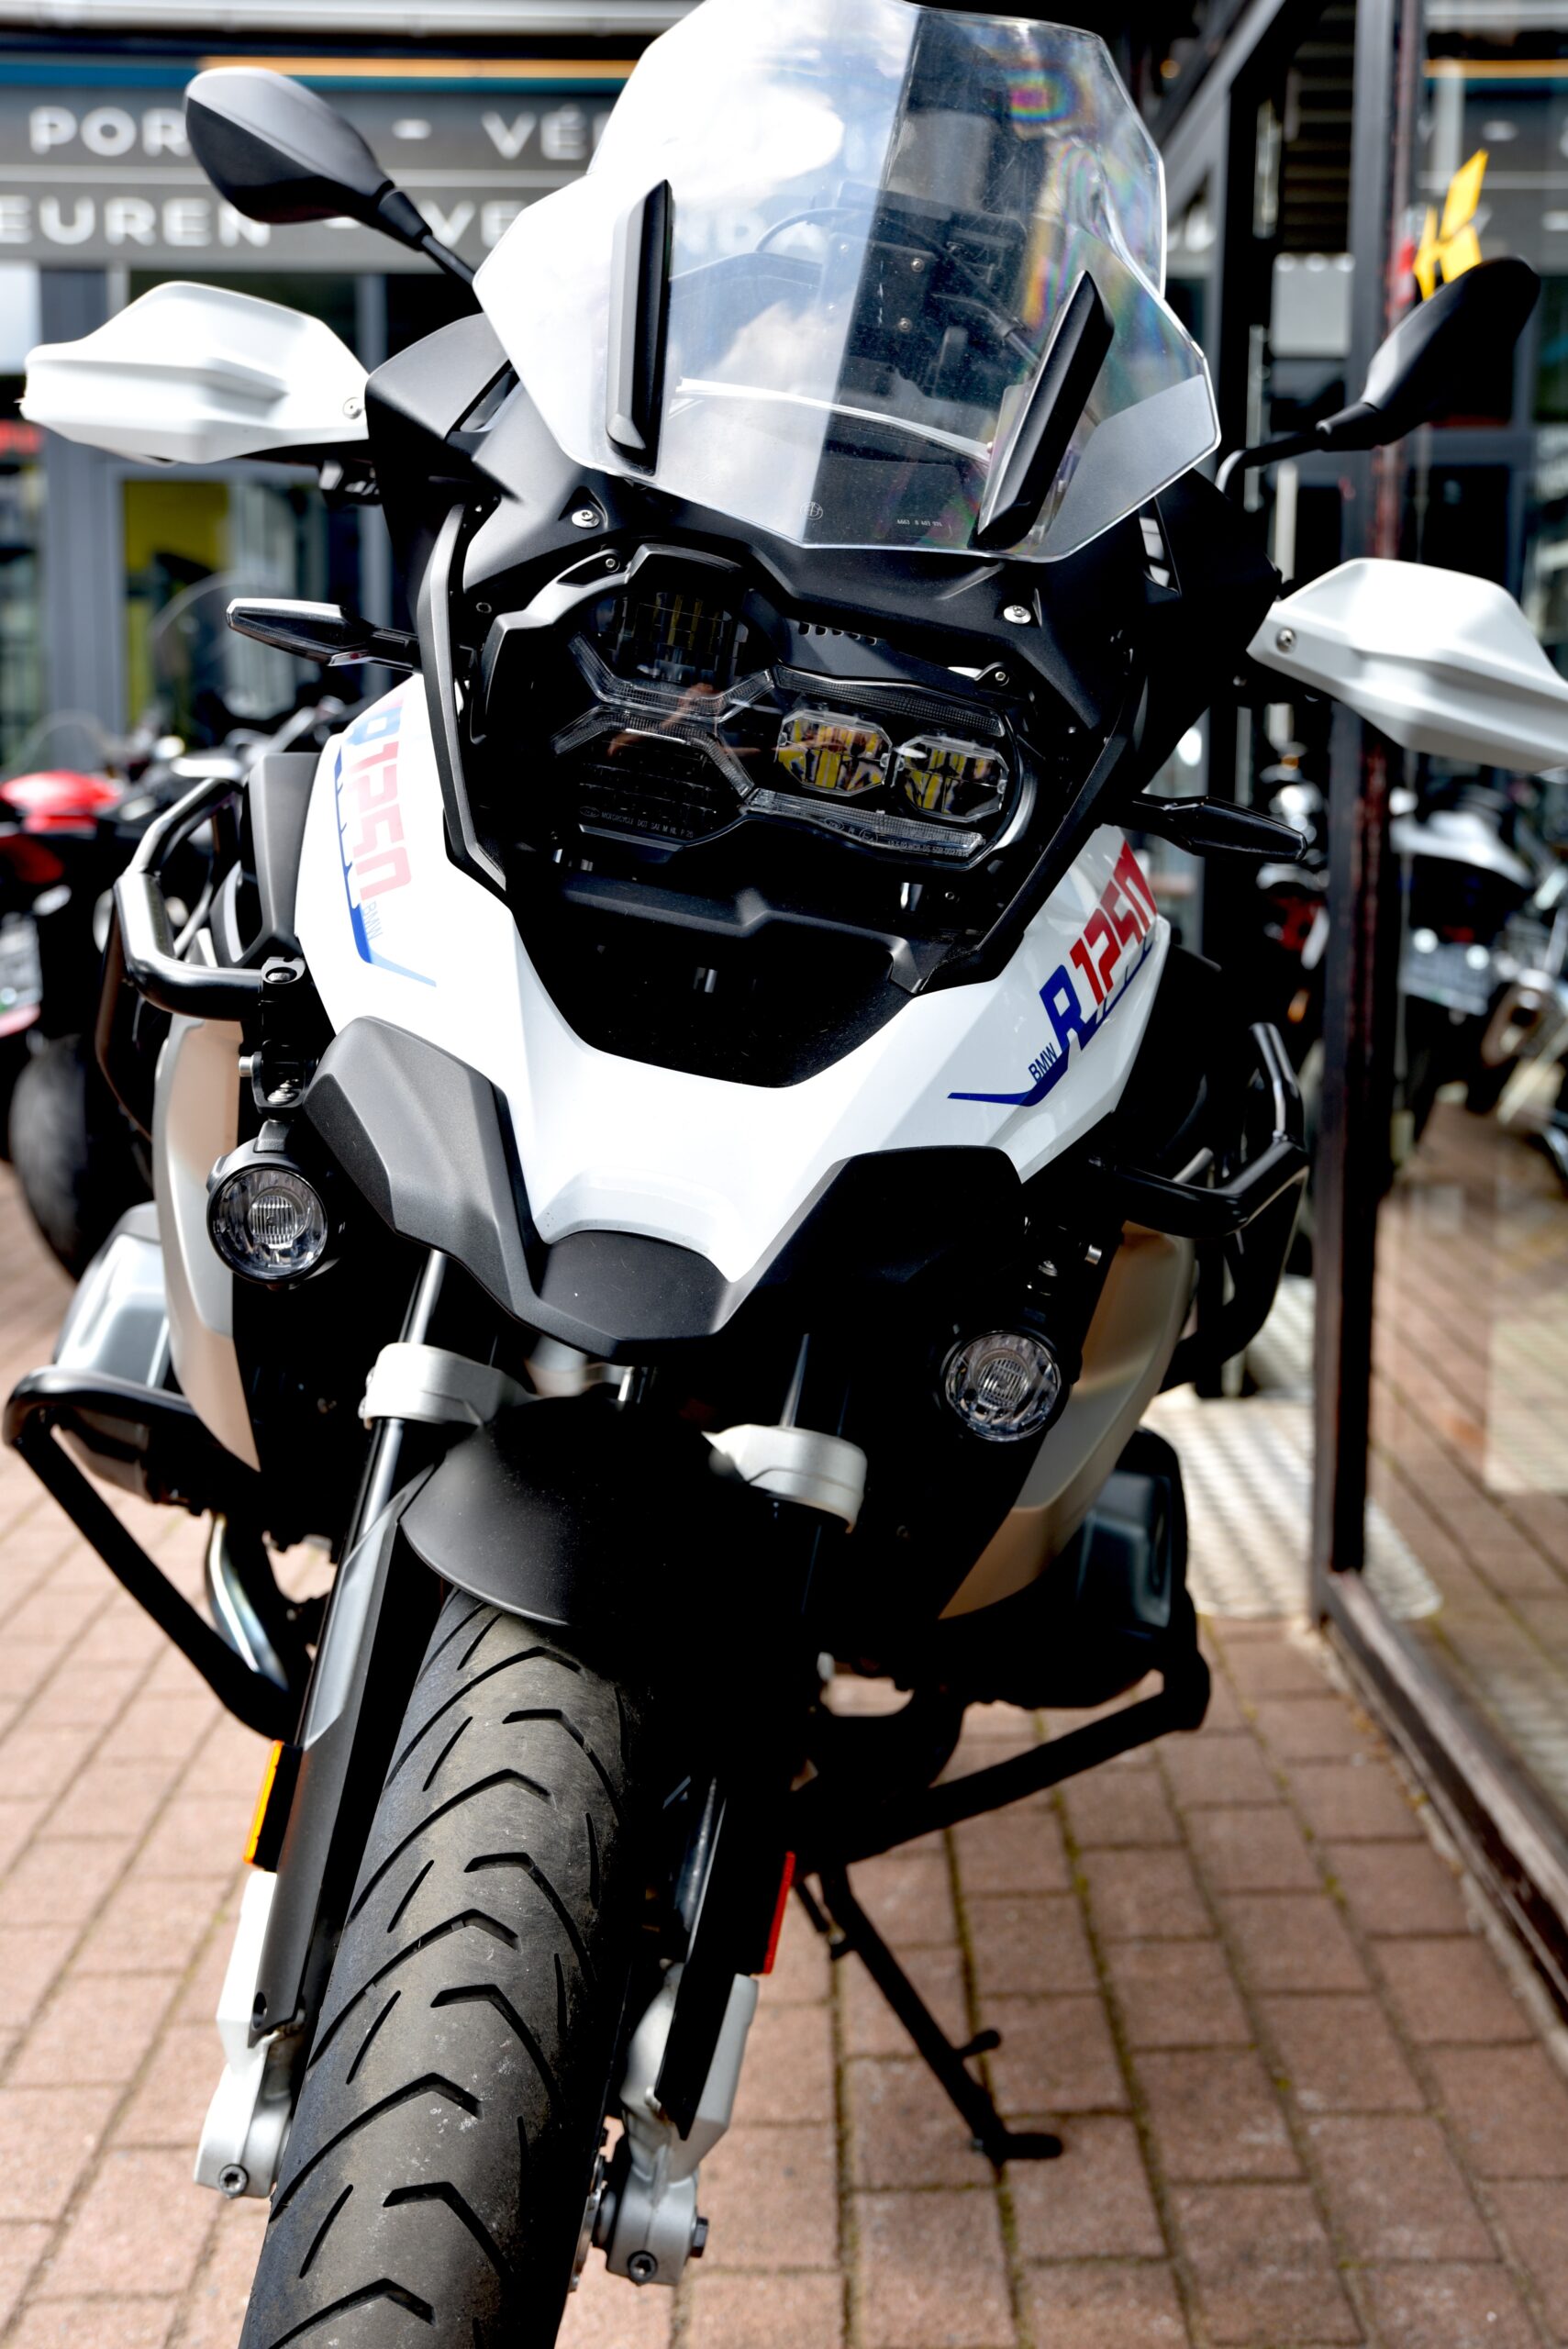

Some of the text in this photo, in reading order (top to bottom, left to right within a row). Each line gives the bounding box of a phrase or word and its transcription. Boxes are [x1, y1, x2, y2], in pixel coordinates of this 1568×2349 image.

[28, 106, 191, 157] POR
[481, 104, 612, 160] VÉ
[1028, 1042, 1058, 1084] BMW
